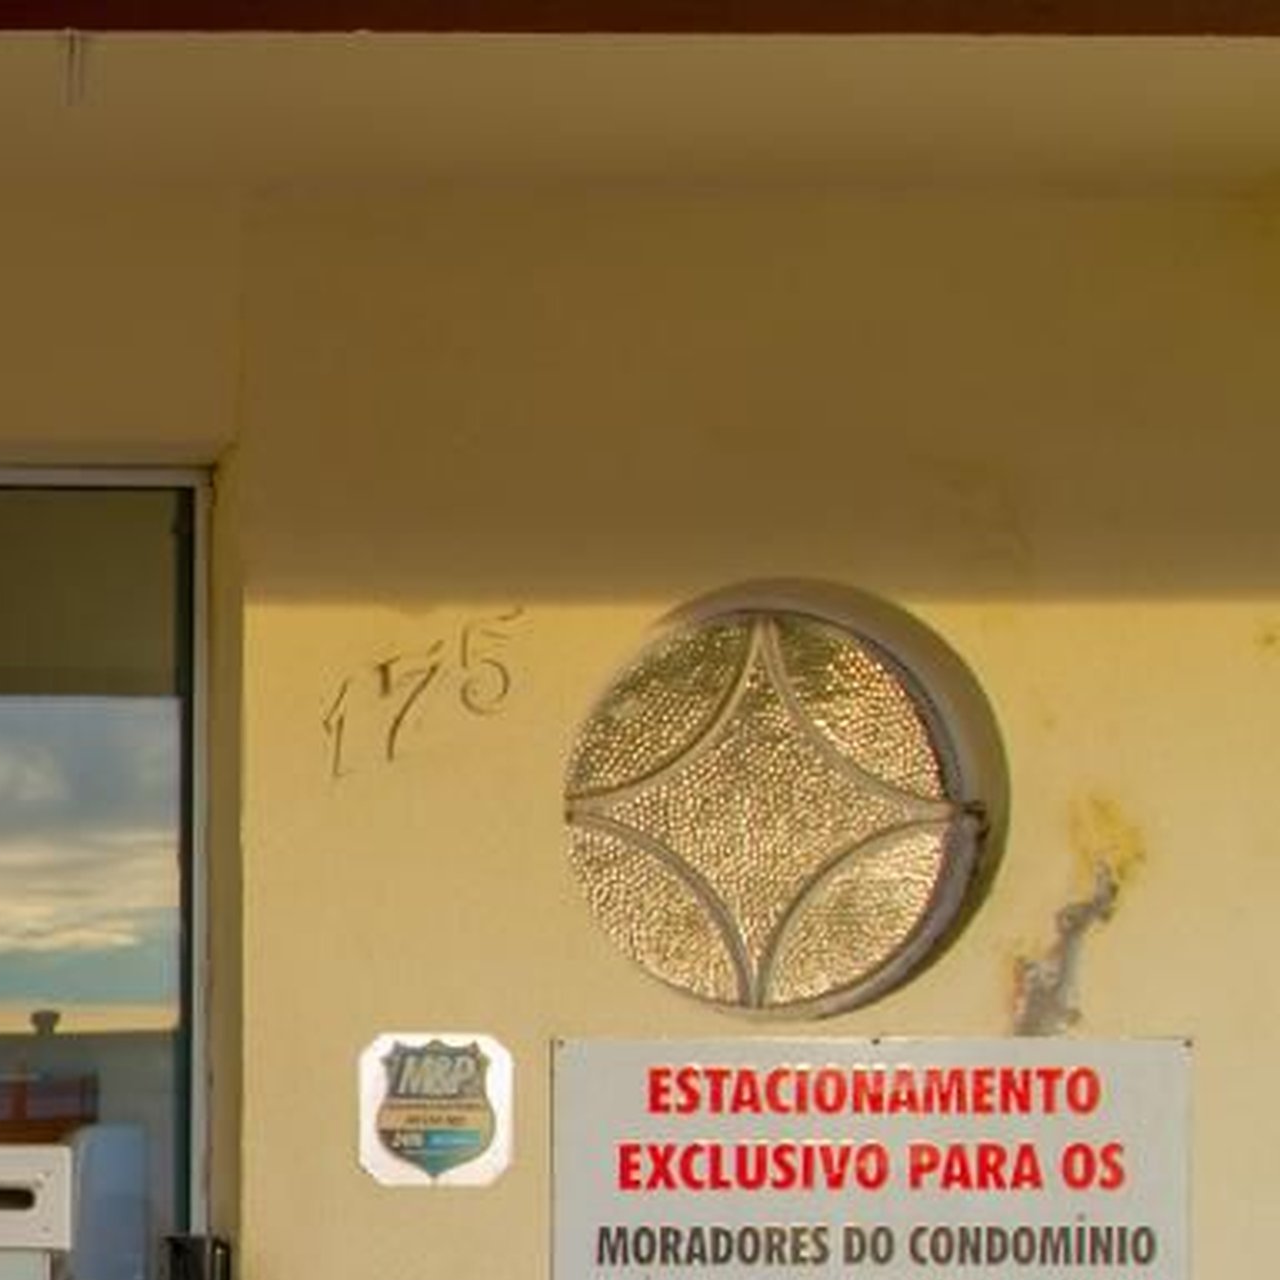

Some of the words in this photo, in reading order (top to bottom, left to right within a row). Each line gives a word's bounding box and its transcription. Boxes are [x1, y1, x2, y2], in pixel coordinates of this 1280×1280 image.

[647, 1066, 1100, 1114] ESTACIONAMENTO
[618, 1143, 889, 1190] EXCLUSIVO
[909, 1143, 1043, 1190] PARA
[1062, 1142, 1126, 1190] OS
[596, 1226, 829, 1266] MORADORES
[843, 1226, 895, 1266] DO
